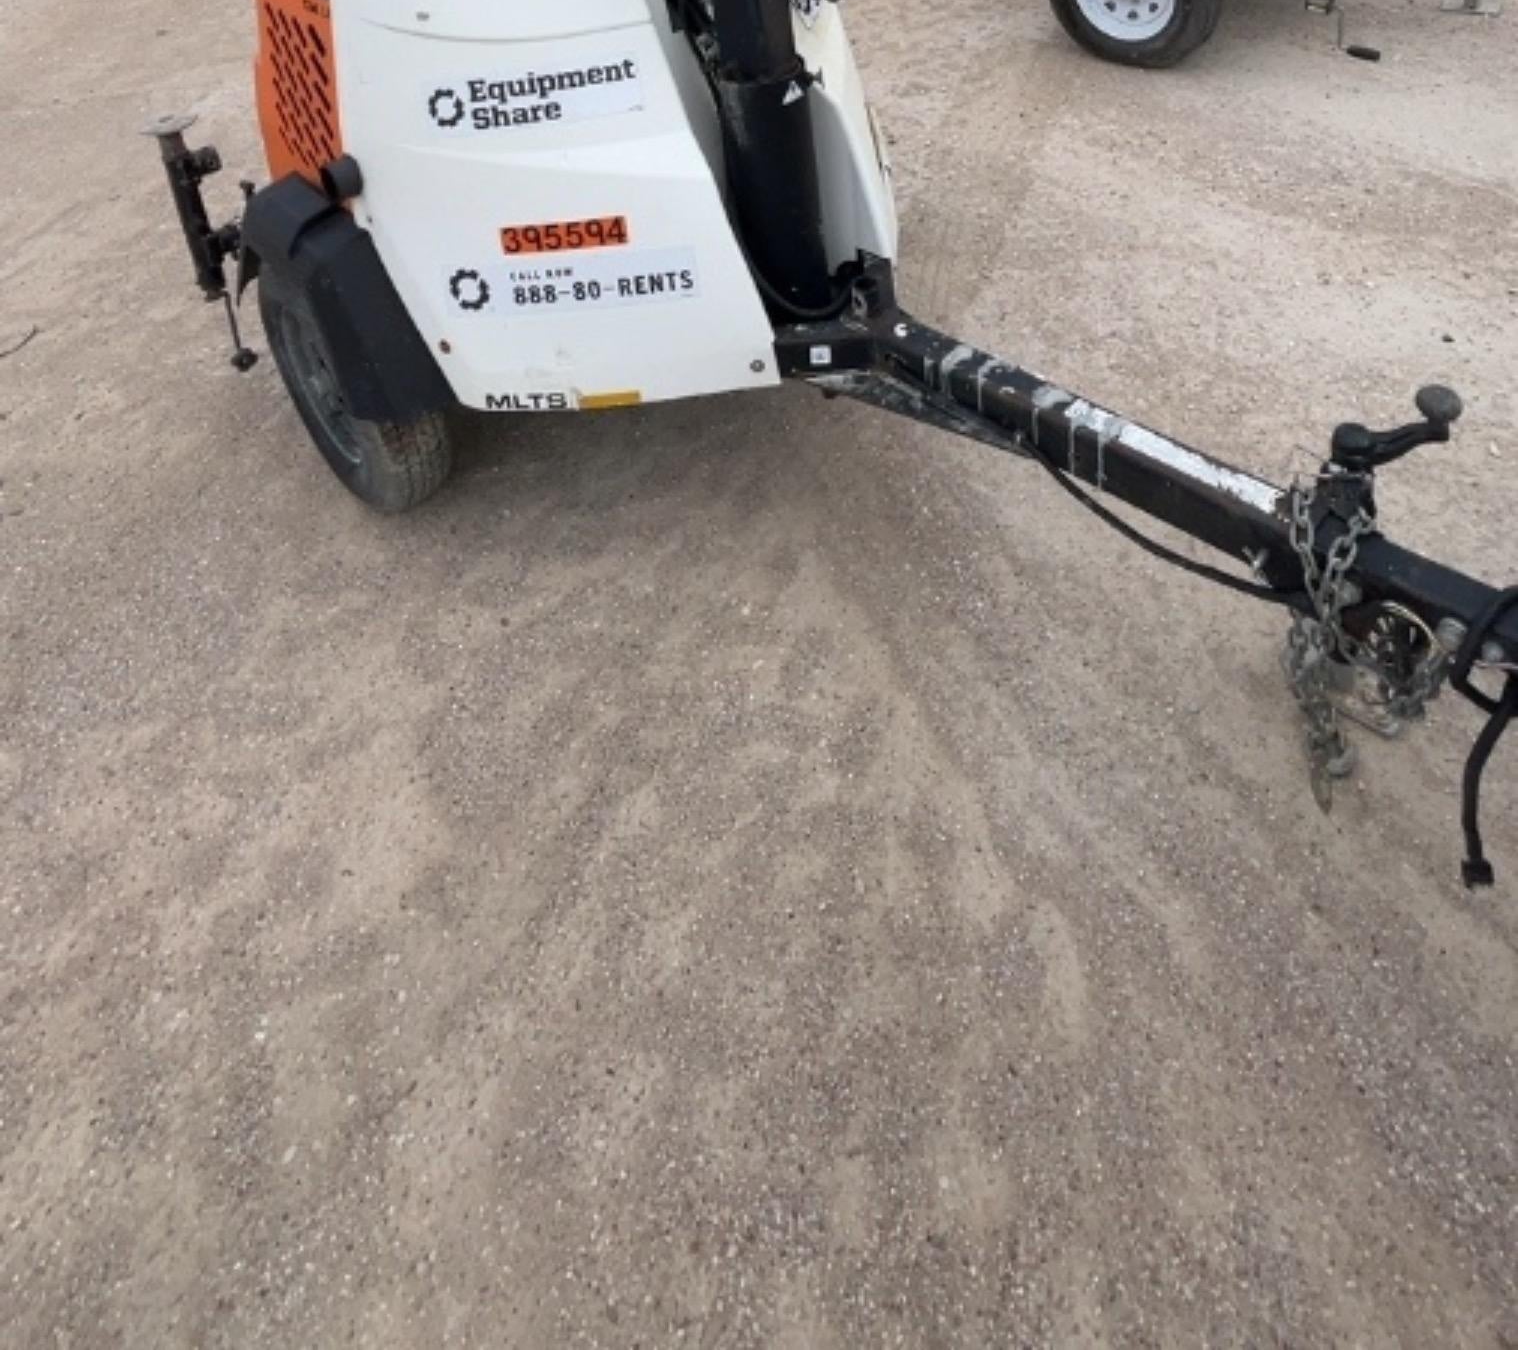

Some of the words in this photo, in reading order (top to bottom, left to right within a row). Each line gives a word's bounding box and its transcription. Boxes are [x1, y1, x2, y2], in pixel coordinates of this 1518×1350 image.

[466, 58, 636, 104] Equipment
[471, 100, 562, 130] Share
[502, 215, 627, 254] 395594
[513, 269, 694, 305] 888-80-RENTS
